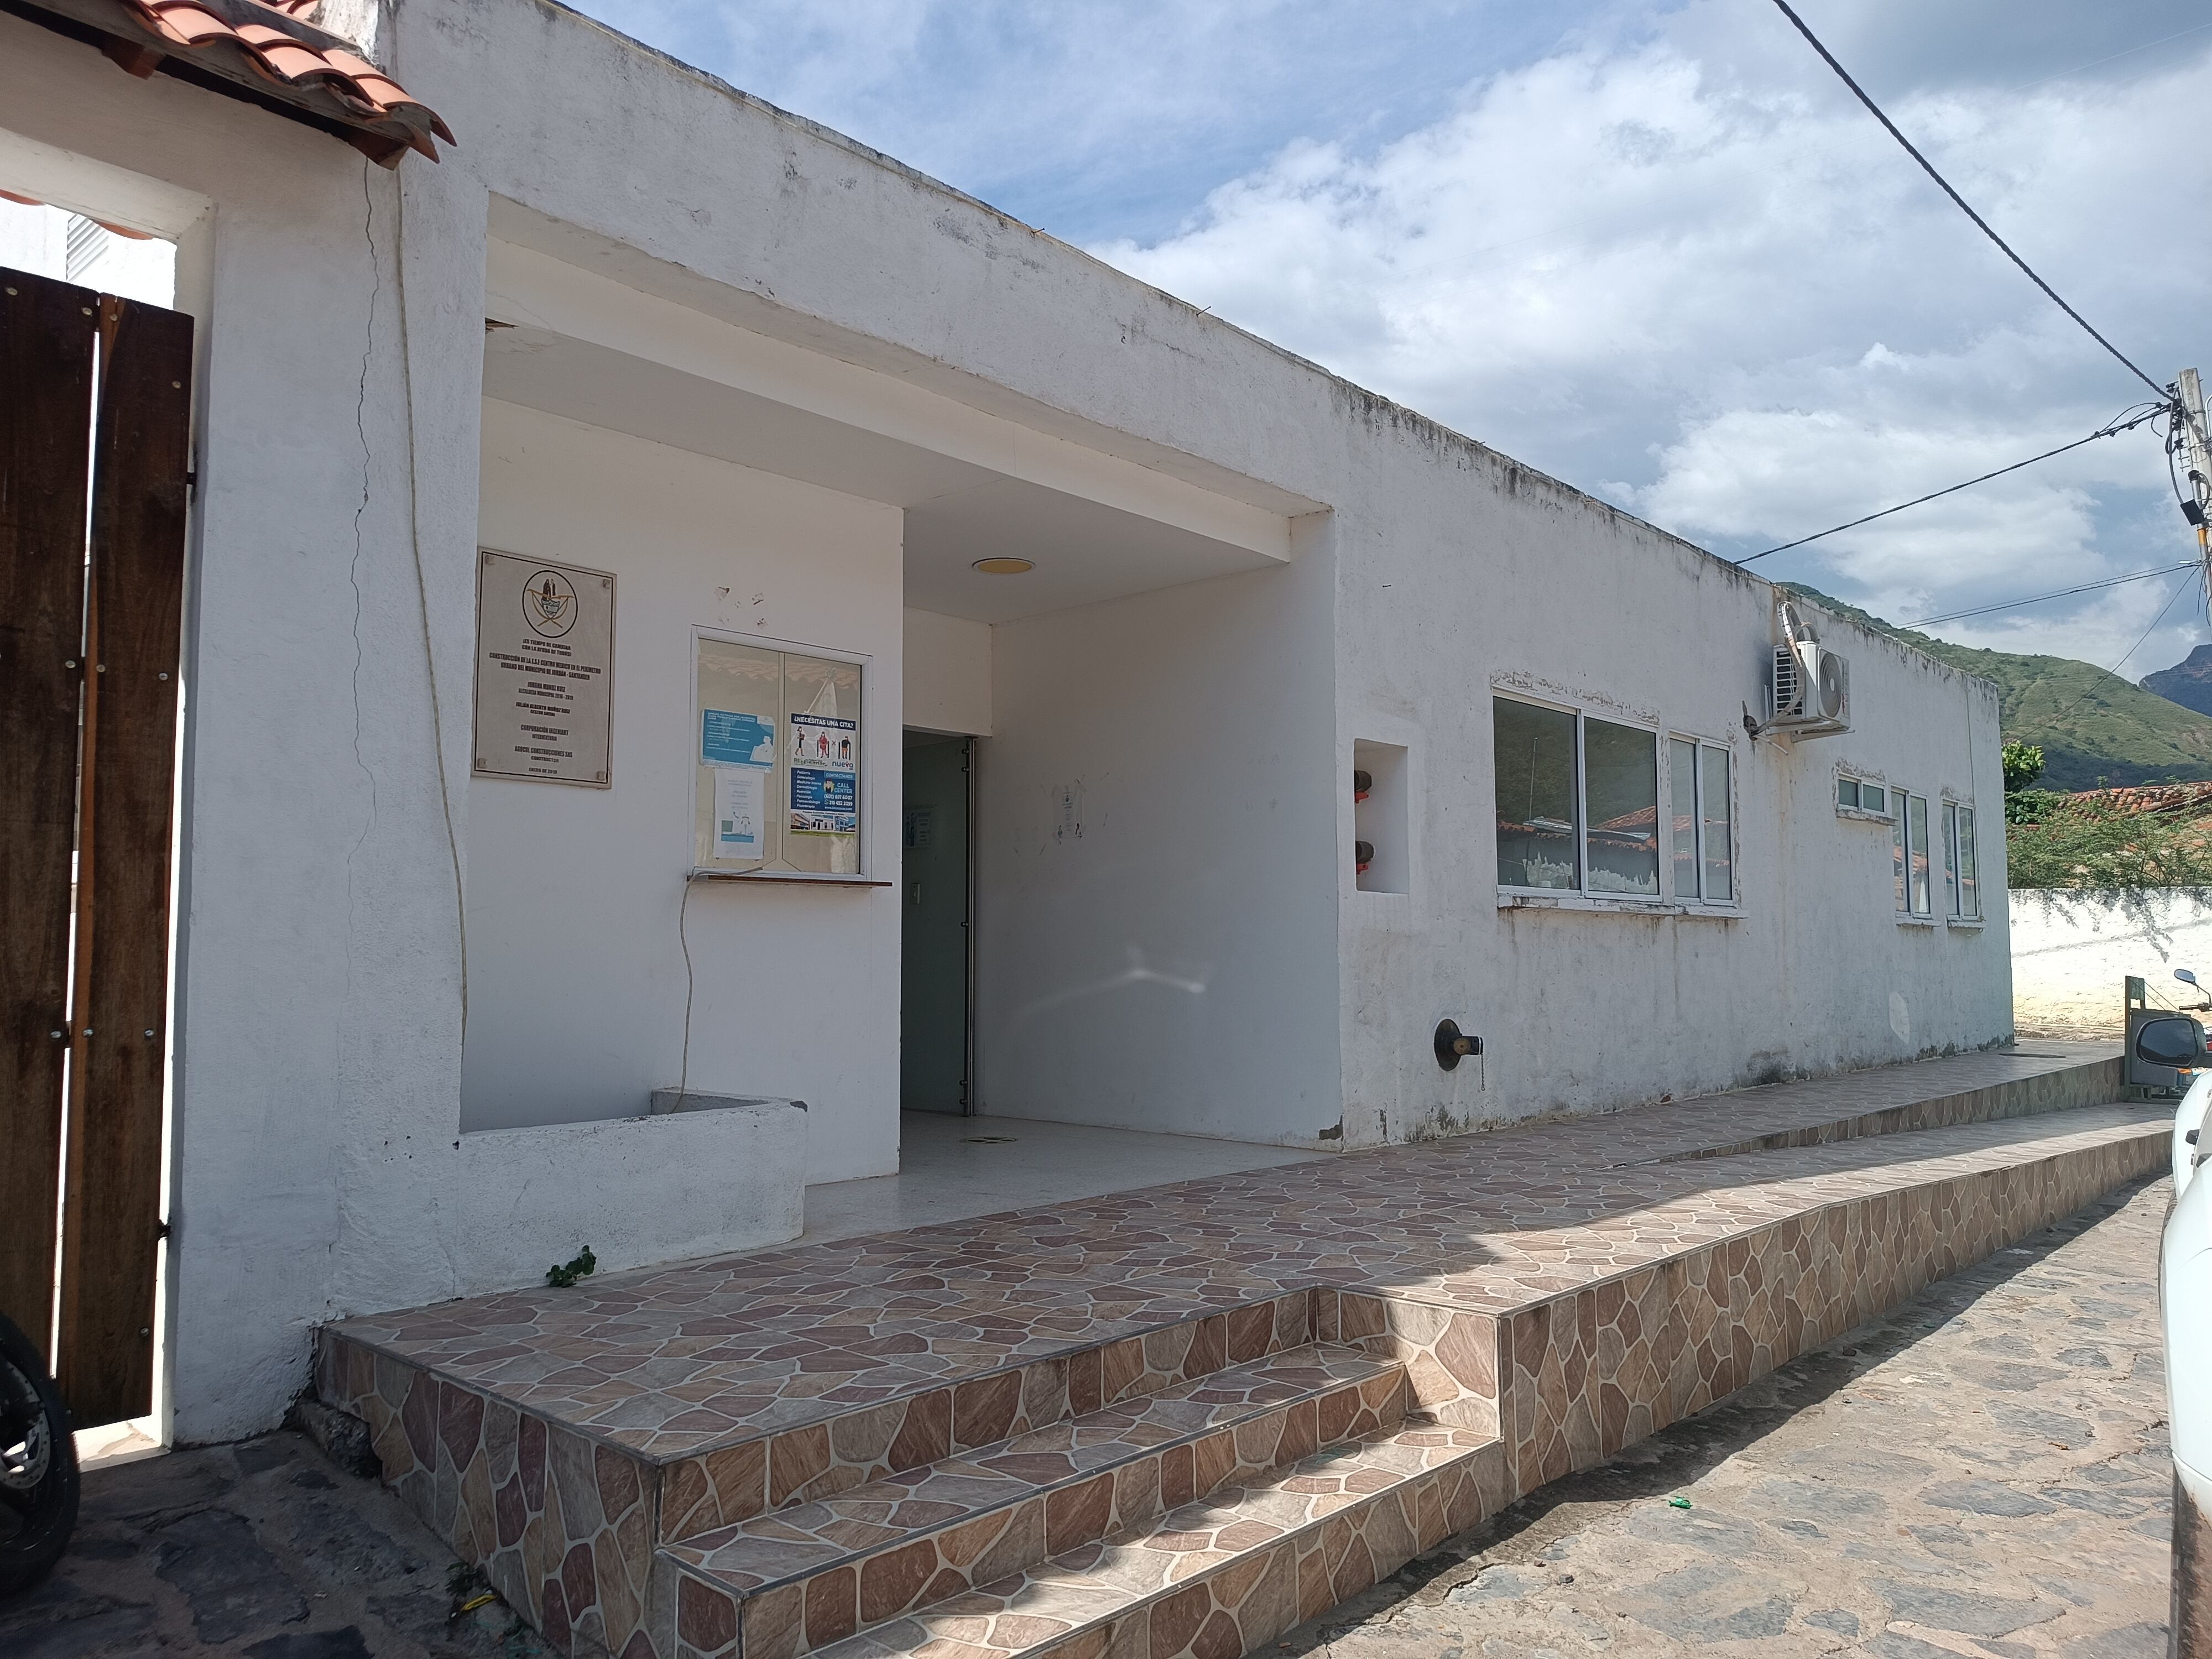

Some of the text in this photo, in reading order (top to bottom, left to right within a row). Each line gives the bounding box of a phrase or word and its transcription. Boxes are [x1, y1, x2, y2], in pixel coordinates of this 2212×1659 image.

[489, 653, 520, 662] CONSTRUCCIÓN
[525, 665, 546, 674] MUNICIPIO
[568, 672, 589, 680] SANTANDER
[794, 716, 826, 725] ¿NECESITAS
[521, 724, 548, 733] CORPORACIÓN
